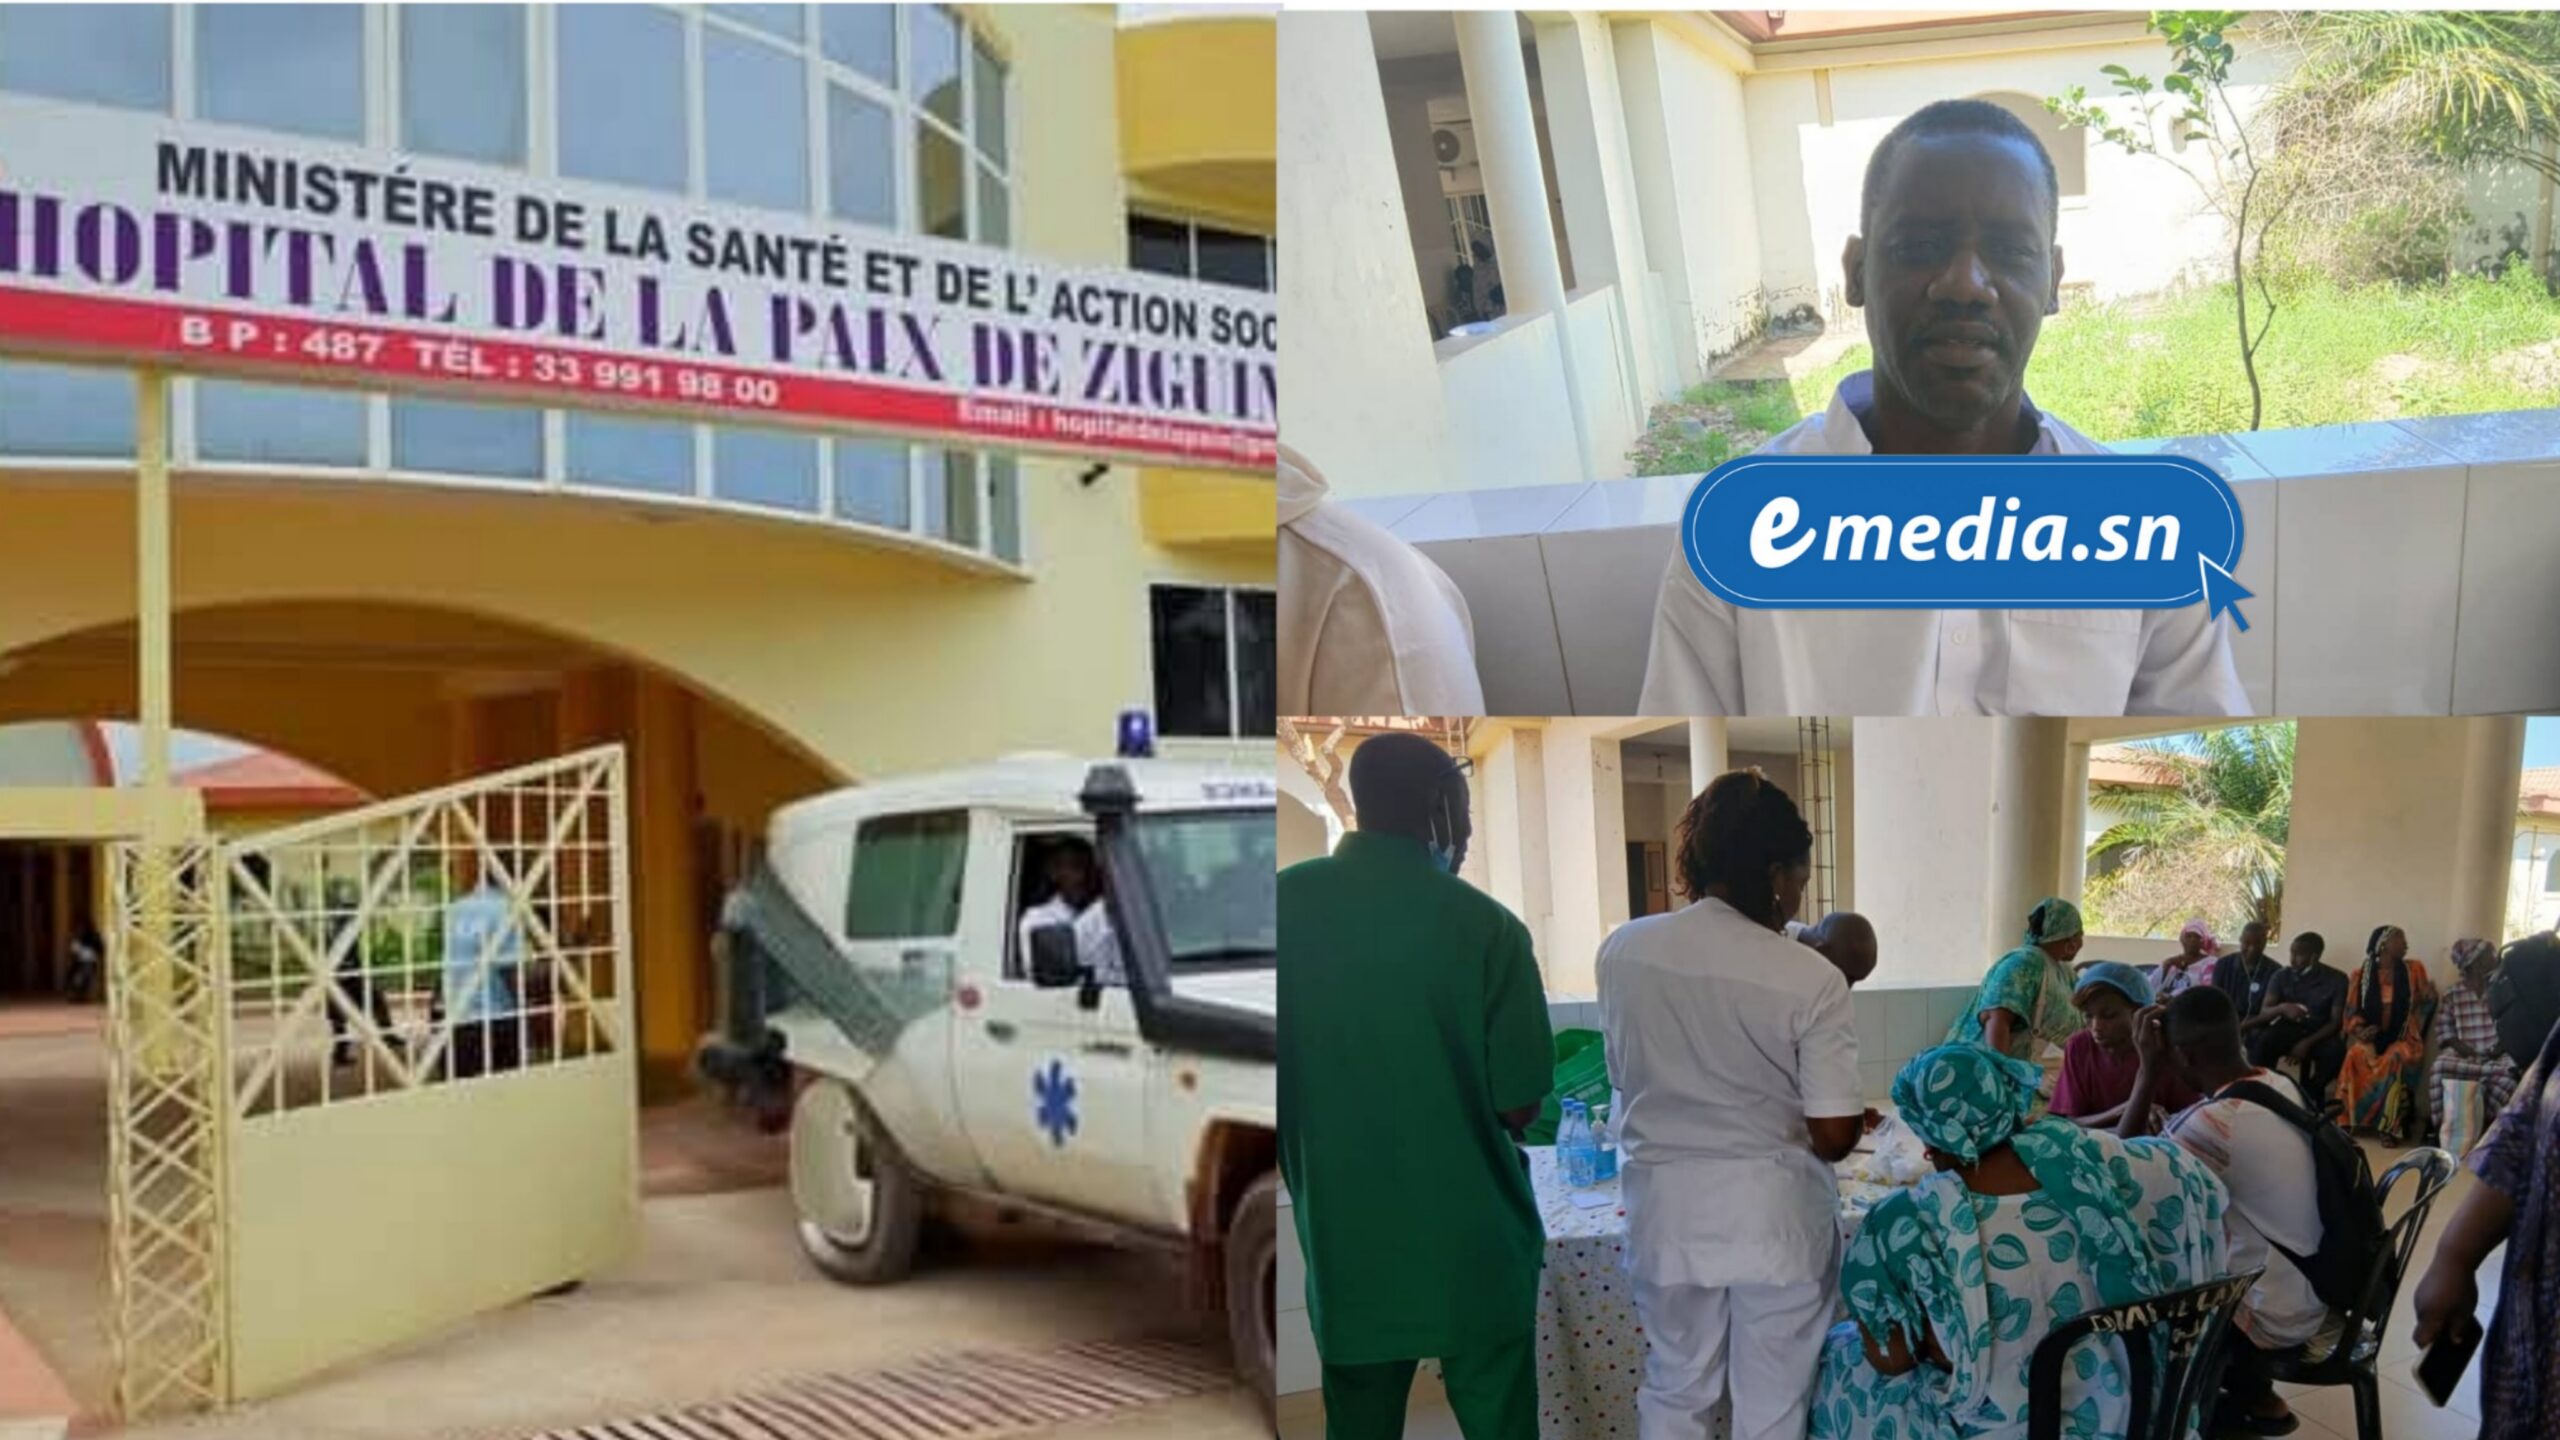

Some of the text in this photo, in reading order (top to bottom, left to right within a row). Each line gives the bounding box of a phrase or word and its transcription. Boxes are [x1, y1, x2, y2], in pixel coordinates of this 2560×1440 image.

[0, 189, 456, 324] HOPITAL
[493, 256, 605, 341] DE
[638, 275, 737, 356] LA
[770, 293, 943, 382] PAIX
[974, 322, 1059, 396] DE
[157, 142, 495, 237] MINISTÉRE
[516, 195, 585, 250] DE
[604, 209, 670, 264] LA
[687, 222, 848, 288] SANTÉ
[865, 252, 919, 297] ET
[936, 261, 991, 308] DE
[1051, 280, 1197, 340] ACTION
[180, 316, 213, 346] B
[229, 321, 257, 350] P
[302, 329, 385, 362] 487
[533, 353, 581, 383] 33
[594, 361, 662, 393] 991
[677, 370, 723, 398] 98
[734, 376, 779, 405] 00
